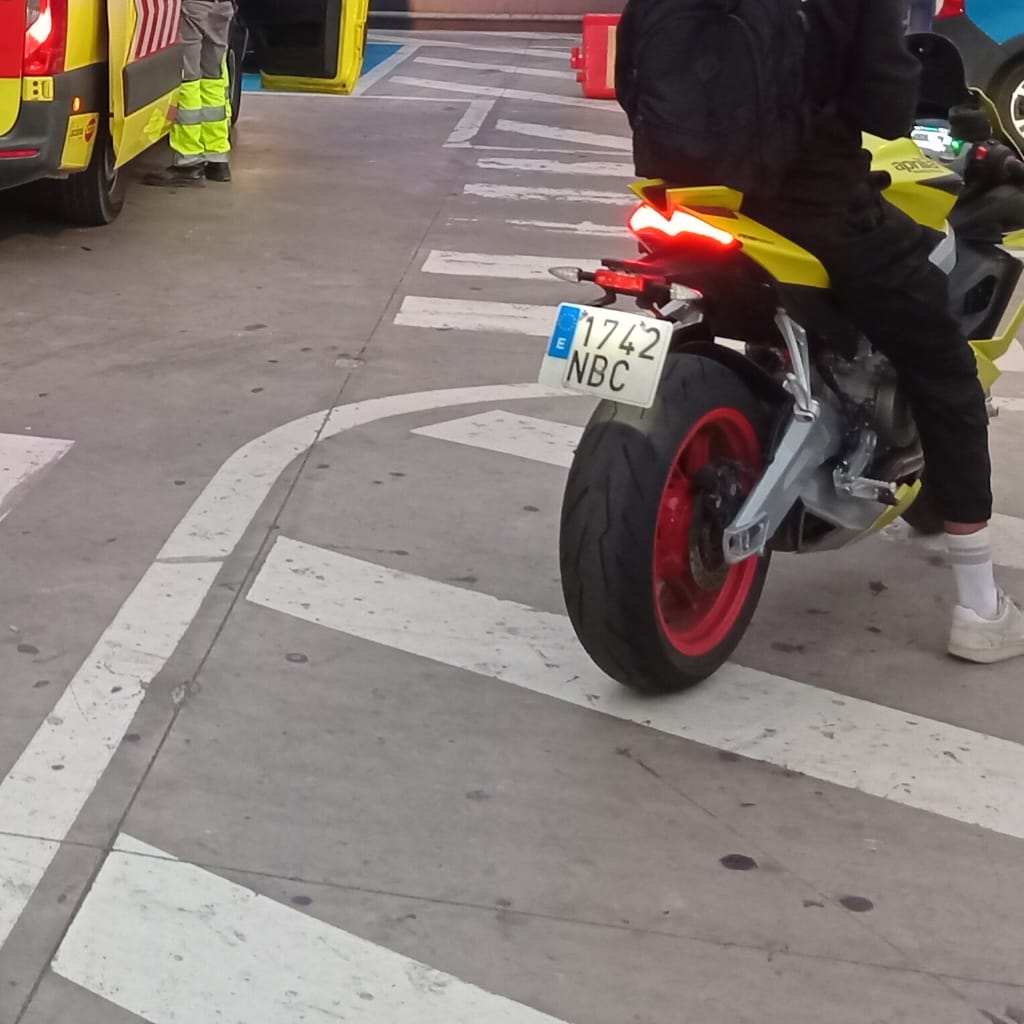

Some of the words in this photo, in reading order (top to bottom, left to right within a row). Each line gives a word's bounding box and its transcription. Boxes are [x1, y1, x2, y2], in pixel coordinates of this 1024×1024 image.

[556, 337, 567, 350] E
[583, 315, 661, 361] 1742
[566, 349, 629, 392] NBC
